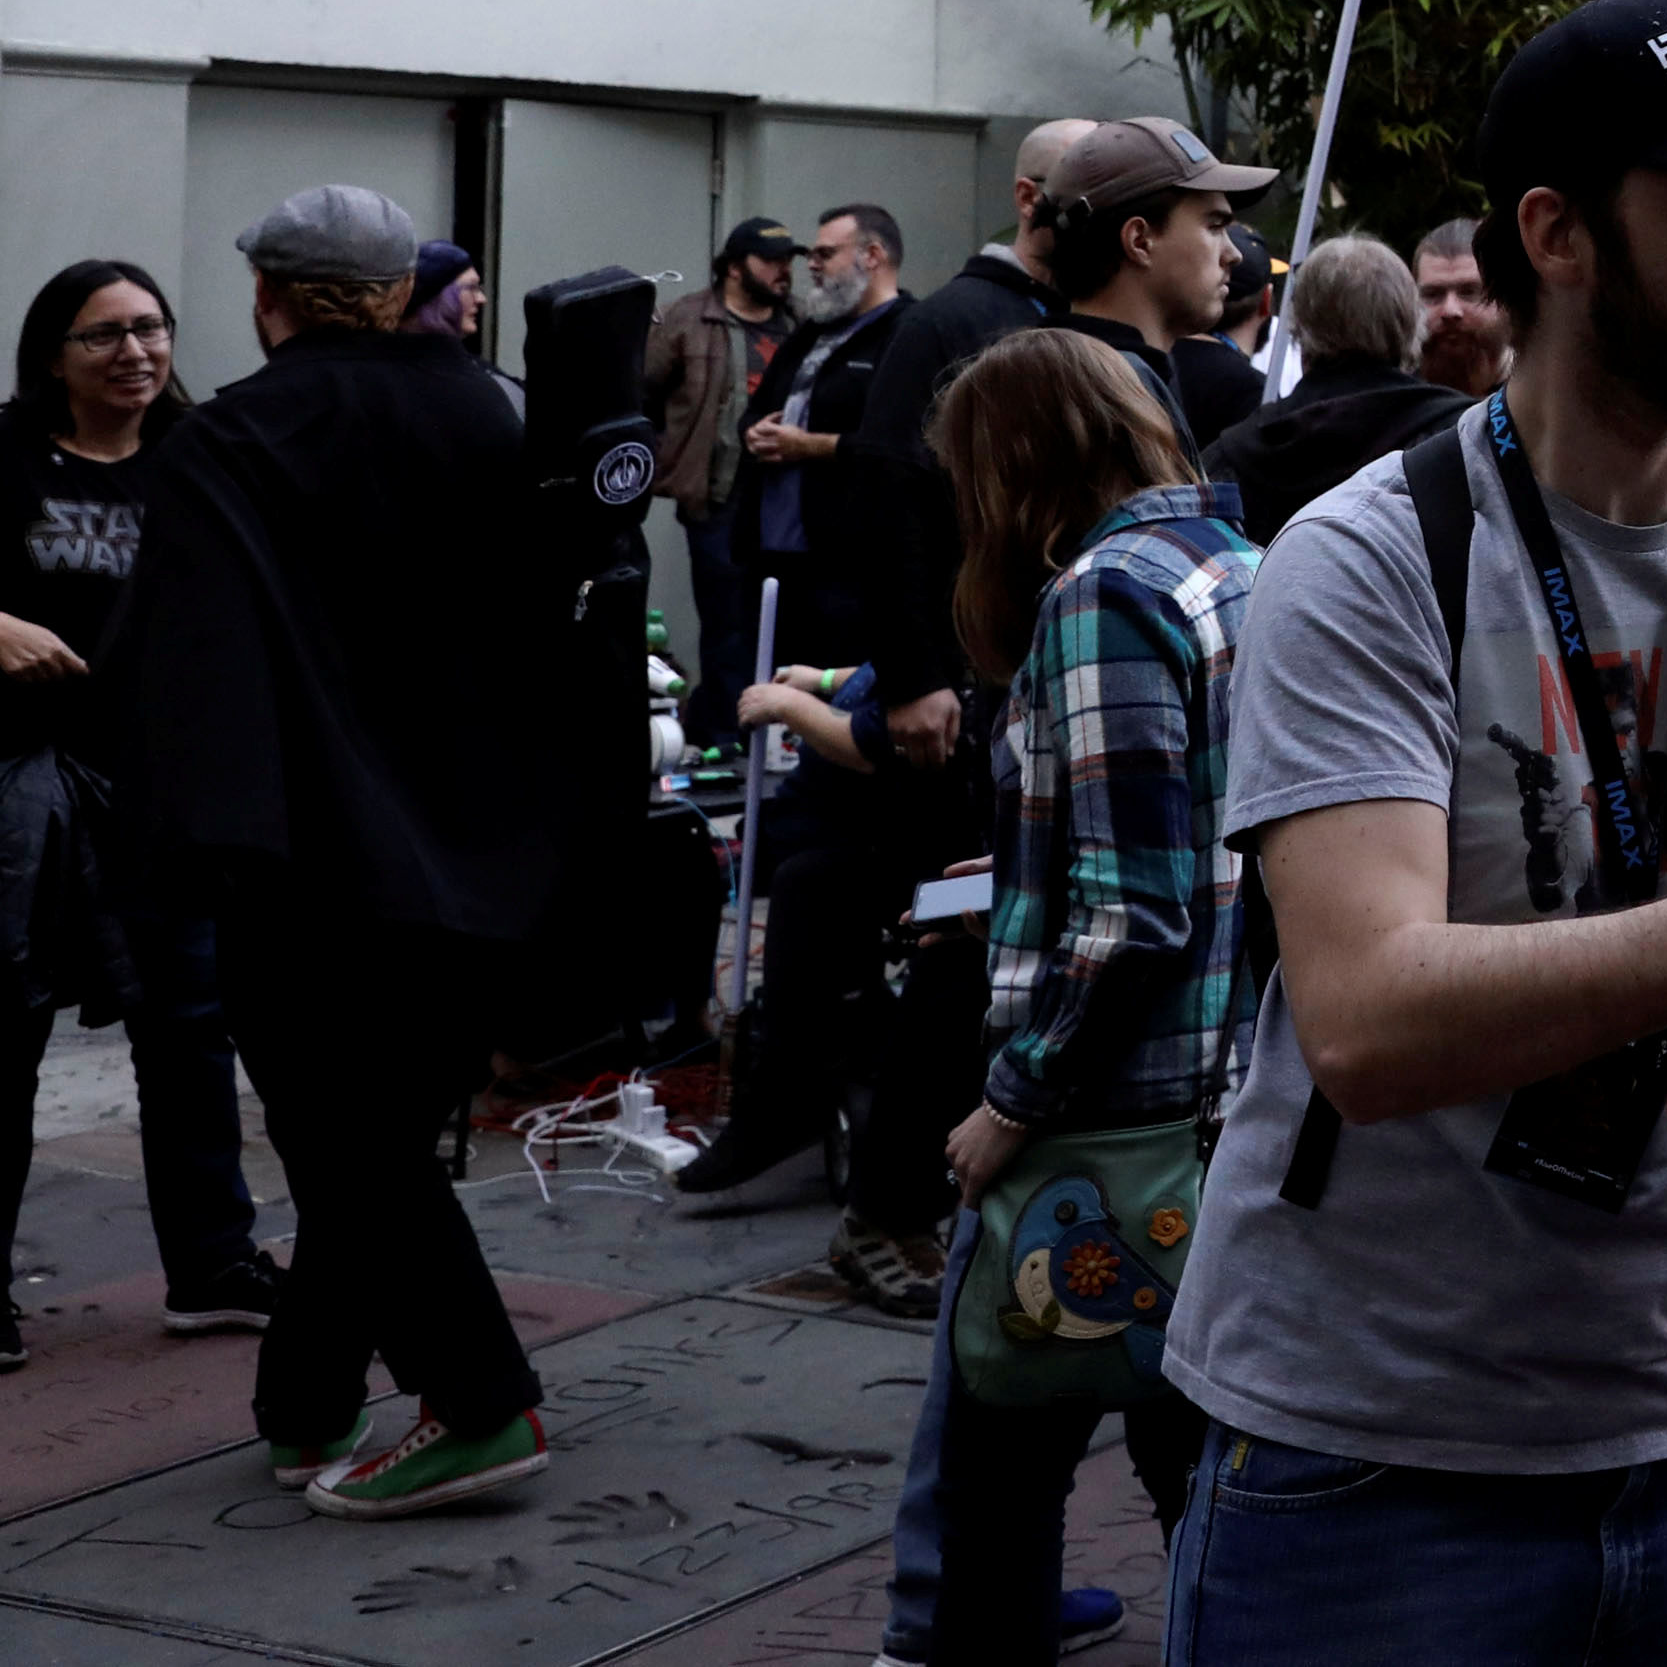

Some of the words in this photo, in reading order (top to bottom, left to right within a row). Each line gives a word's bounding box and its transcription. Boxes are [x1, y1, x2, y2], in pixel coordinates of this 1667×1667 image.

[25, 497, 146, 537] STA
[1543, 566, 1584, 657] IMAX
[1603, 778, 1648, 870] IMAX
